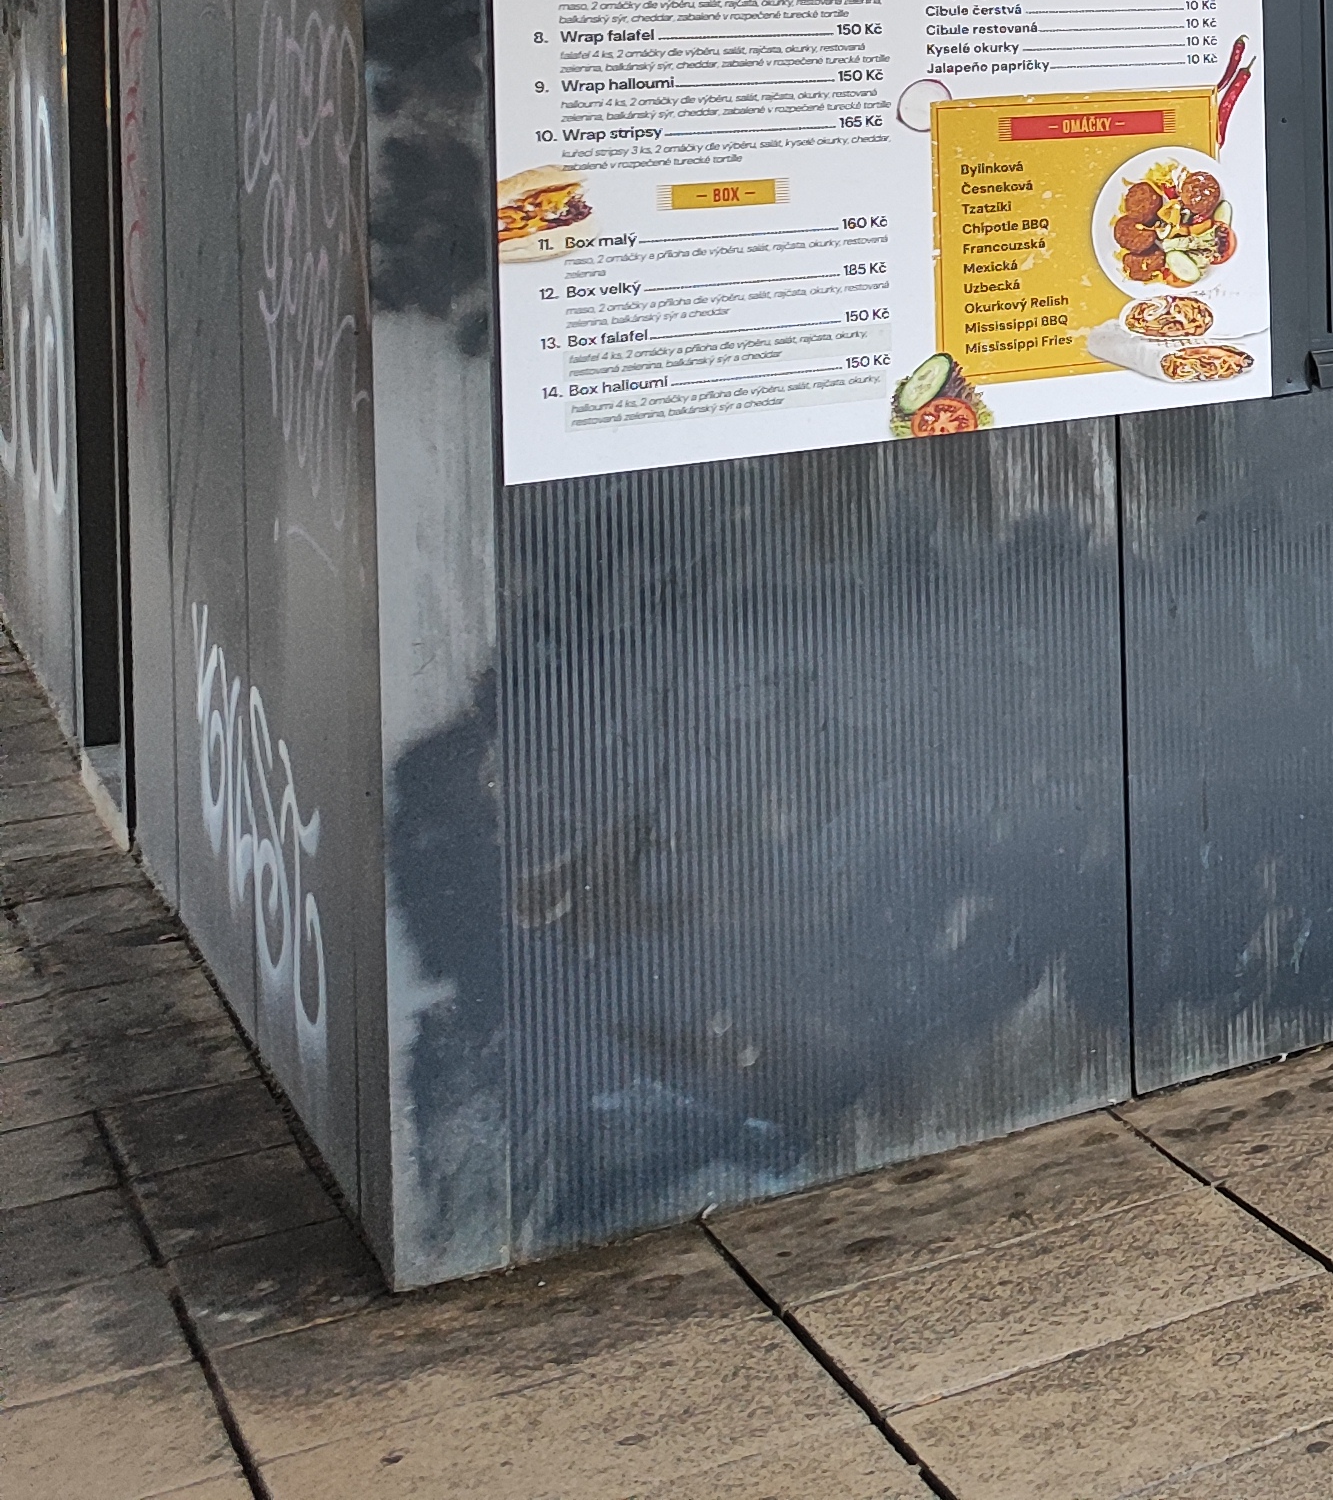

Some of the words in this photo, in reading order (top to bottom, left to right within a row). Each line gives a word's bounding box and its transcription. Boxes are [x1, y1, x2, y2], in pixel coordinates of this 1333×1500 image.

[926, 5, 968, 16] Cibule
[973, 4, 1021, 15] čerstvá
[560, 31, 603, 45] Wrap
[607, 29, 654, 41] falafel
[837, 24, 861, 35] 150
[926, 24, 969, 35] Cibule
[973, 22, 1037, 34] restovaná
[927, 43, 970, 57] Kyselé
[974, 42, 1019, 54] okurky
[927, 62, 988, 75] Jalapeňo
[992, 60, 1049, 74] papričky
[561, 80, 605, 94] Wrap
[609, 76, 674, 90] halloumi
[838, 70, 862, 81] 150
[562, 129, 606, 142] Wrap
[610, 127, 661, 141] stripsy
[839, 116, 862, 128] 165
[1063, 116, 1111, 134] OMÁČKY
[961, 161, 1023, 177] Bylinková
[714, 187, 739, 202] BOX
[962, 180, 1033, 194] Česneková
[962, 201, 1011, 214] Tzatziki
[565, 237, 596, 248] Box
[599, 232, 637, 247] malý
[842, 217, 867, 229] 160
[963, 221, 1018, 235] Chipotle
[1022, 219, 1049, 230] BBQ
[963, 238, 1045, 254] Francouzská
[964, 259, 1017, 274] Mexická
[567, 286, 595, 298] Box
[600, 282, 641, 296] velký
[844, 264, 866, 276] 185
[964, 279, 1020, 293] Uzbecká
[965, 298, 1027, 313] Okurkový
[1031, 295, 1068, 308] Relish
[568, 335, 597, 347] Box
[601, 329, 647, 344] falafel
[846, 310, 869, 322] 150
[965, 317, 1037, 333] Mississippi
[1042, 315, 1067, 326] BBQ
[966, 337, 1038, 354] Mississippi
[1042, 335, 1072, 346] Fries
[570, 385, 598, 396] Box
[603, 376, 667, 393] halloumi
[846, 356, 870, 368] 150
